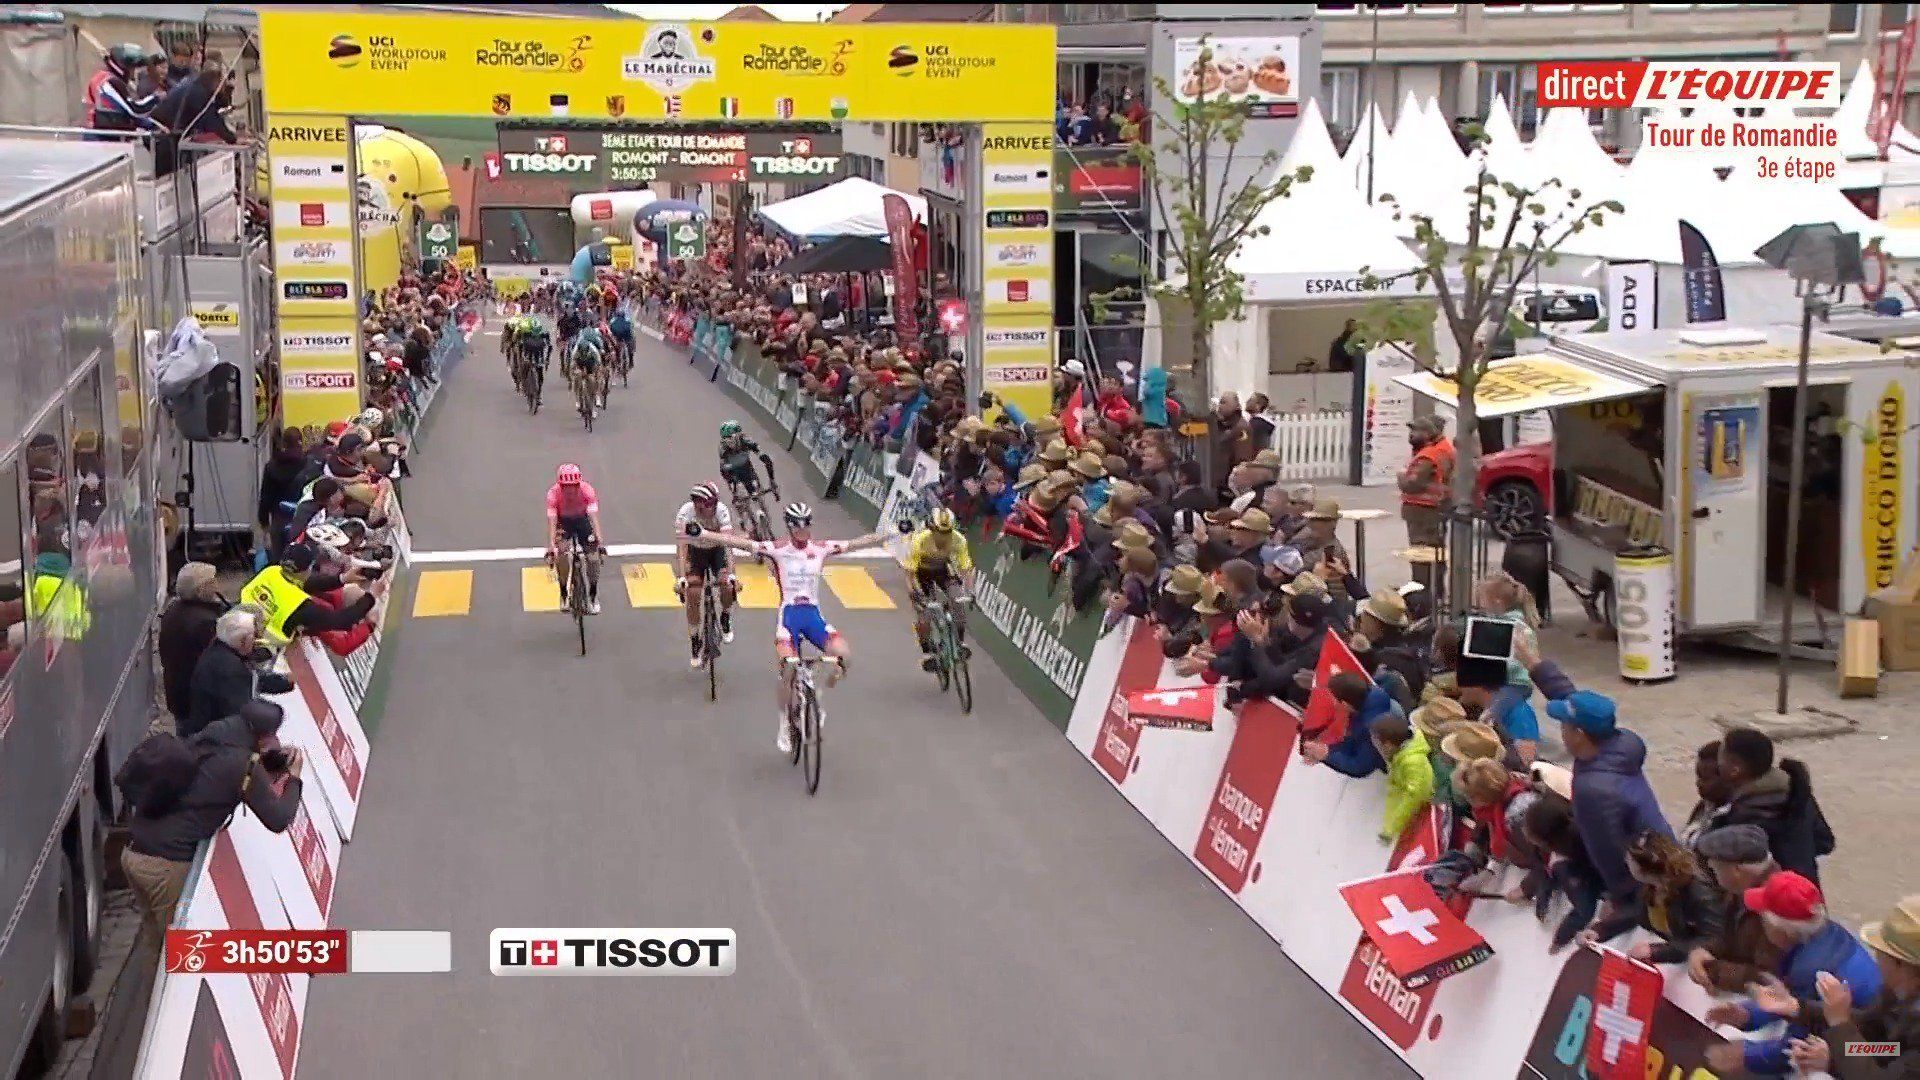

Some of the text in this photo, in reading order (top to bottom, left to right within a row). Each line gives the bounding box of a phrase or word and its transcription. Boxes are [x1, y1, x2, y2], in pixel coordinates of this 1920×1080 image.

[369, 36, 394, 46] UCI
[492, 39, 543, 52] Tour de
[370, 48, 447, 60] WORLDTOUR
[759, 44, 807, 57] Tour de
[926, 45, 949, 56] UCI
[476, 49, 560, 67] Romandie
[743, 54, 823, 71] Romandie
[926, 56, 997, 68] WORLDTOUR
[370, 60, 409, 71] EVENT
[625, 61, 712, 74] LE MARÉCHAL
[926, 68, 960, 78] EVENT
[269, 127, 346, 141] ARRIVEE
[628, 133, 656, 148] ETAPE
[657, 134, 682, 149] TOUR
[683, 135, 696, 149] DE
[697, 134, 747, 150] ROMANDIE
[983, 136, 1051, 150] ARRIVEE
[503, 153, 597, 172] TISSOT
[611, 151, 669, 164] ROMONT
[680, 152, 736, 166] ROMONT
[750, 156, 840, 174] TISSOT
[283, 165, 321, 176] Romont
[431, 245, 448, 257] 50
[679, 245, 695, 258] 50
[1305, 279, 1363, 293] ESPACE
[303, 336, 351, 345] TISSOT
[1004, 331, 1046, 340] TISSOT
[306, 374, 354, 387] SPORT
[1875, 488, 1897, 588] CHICCO
[1219, 772, 1264, 831] banque
[1364, 950, 1422, 1024] léman
